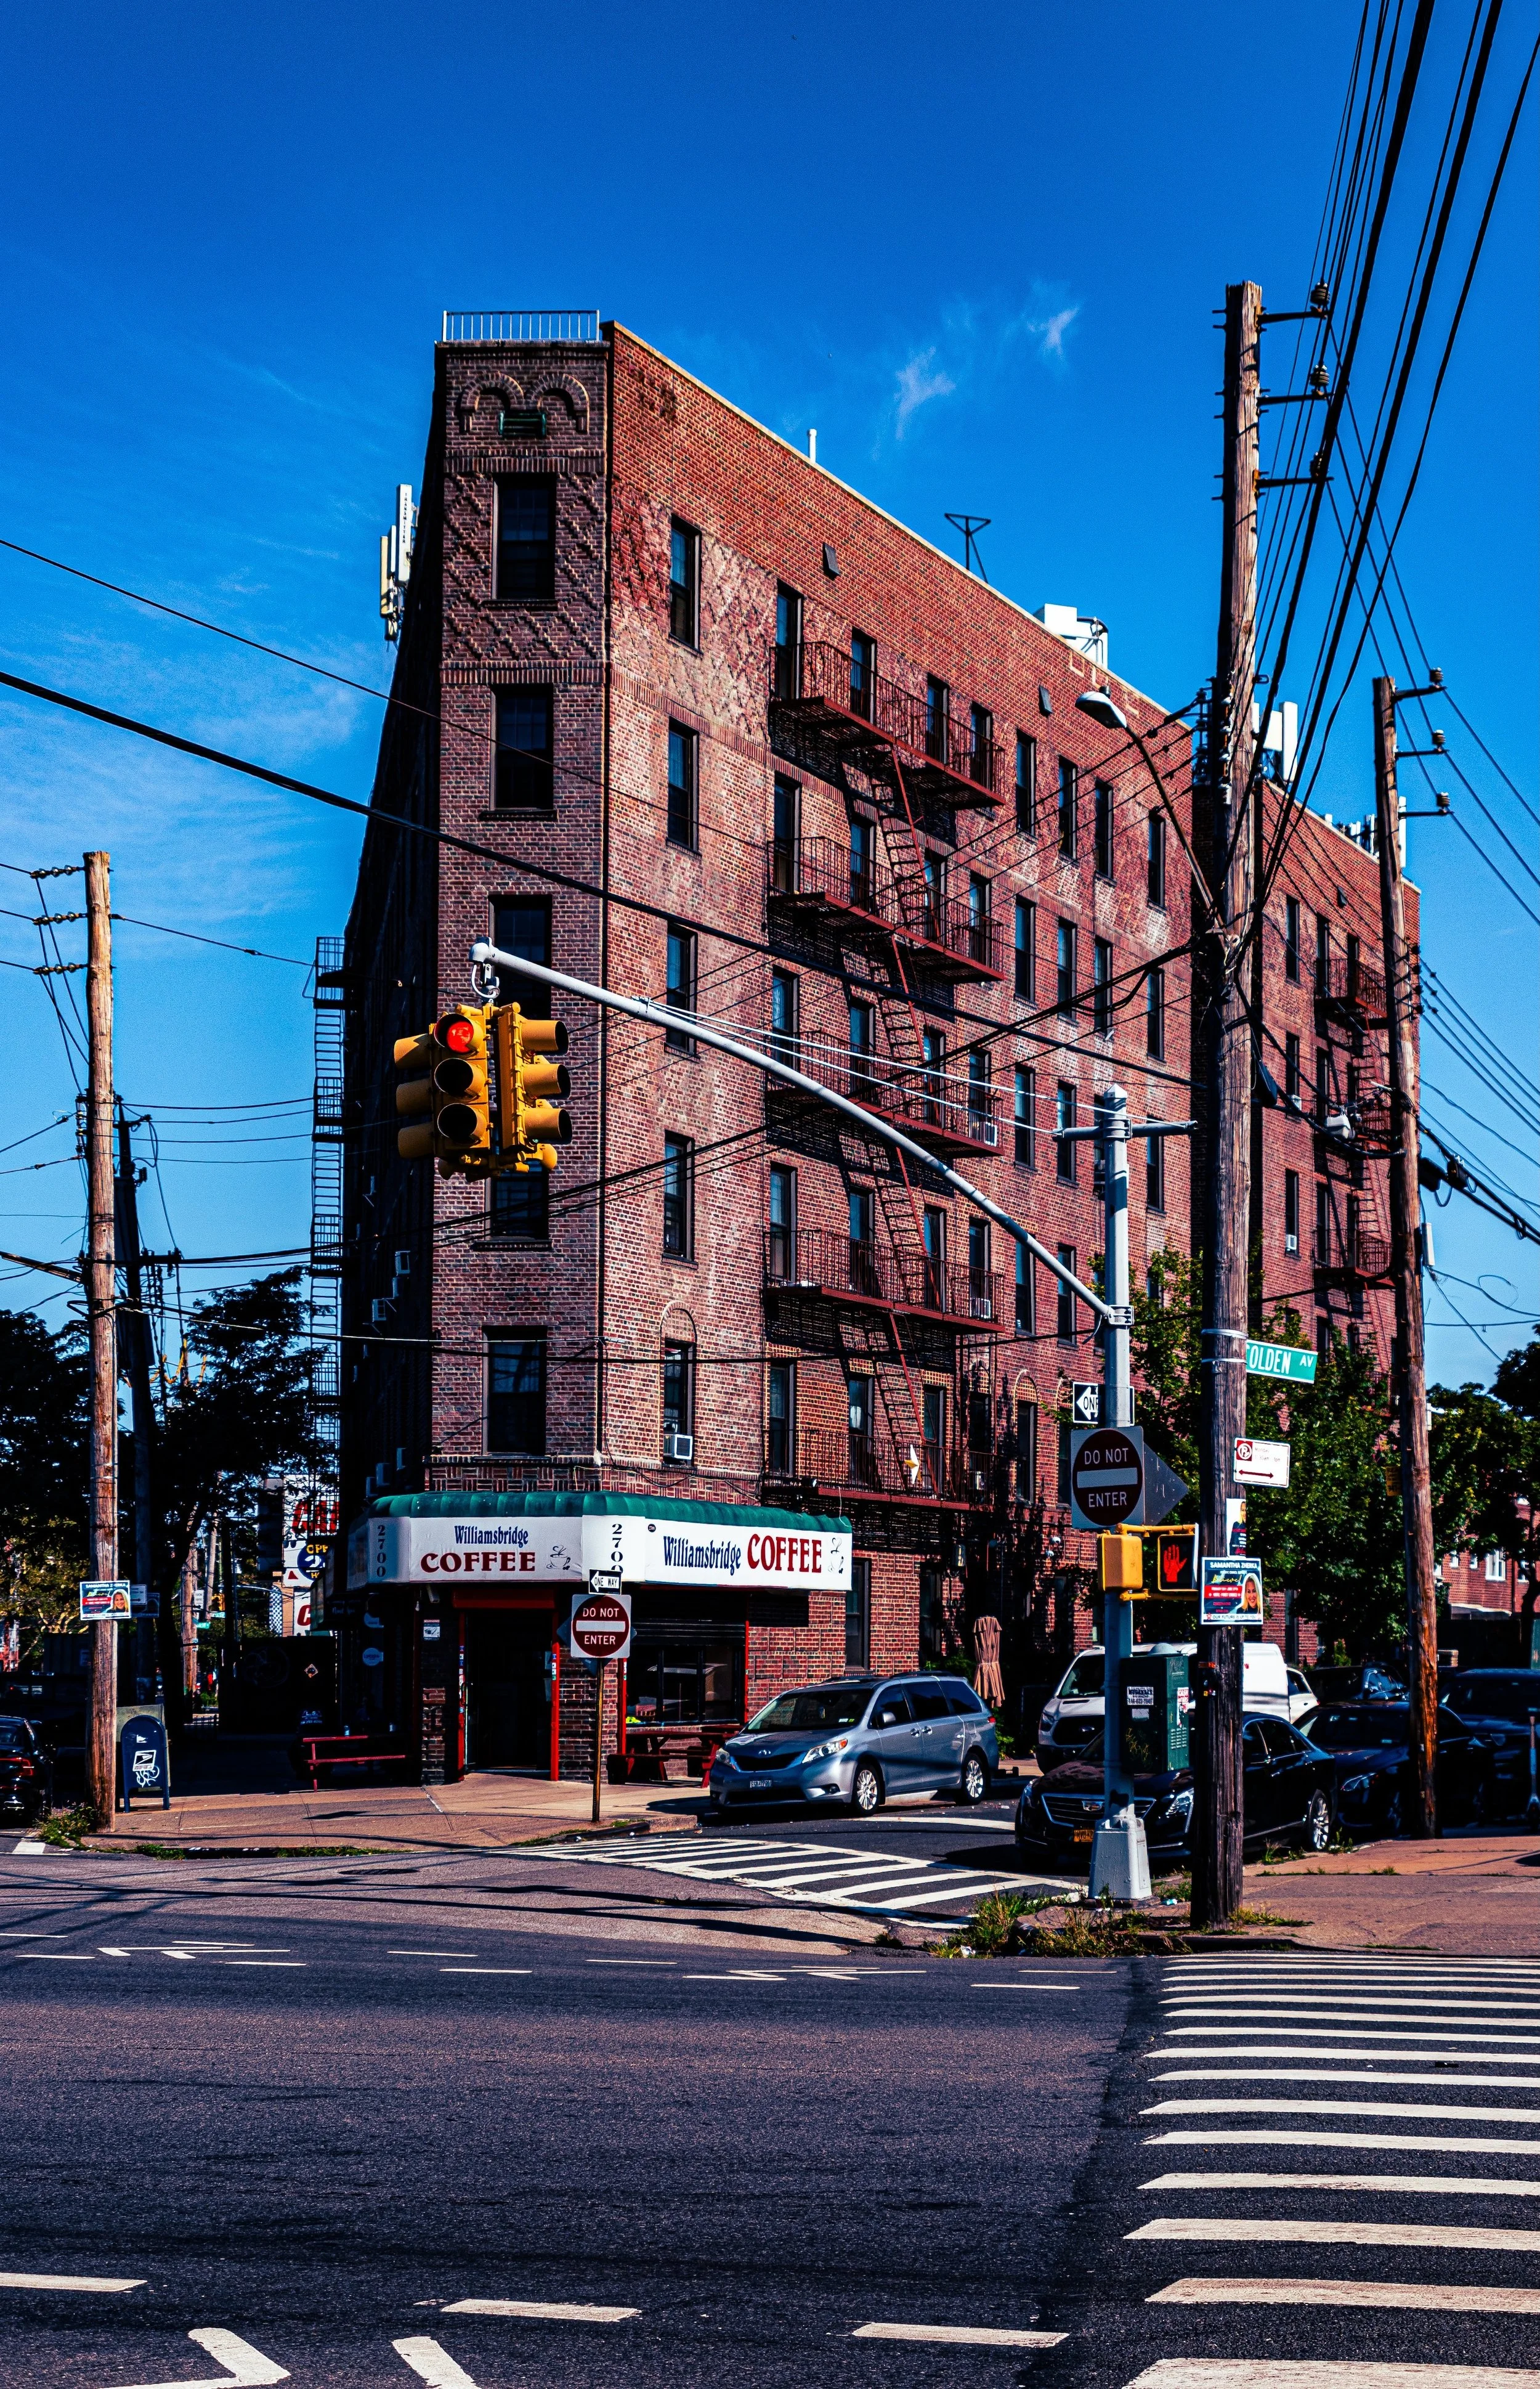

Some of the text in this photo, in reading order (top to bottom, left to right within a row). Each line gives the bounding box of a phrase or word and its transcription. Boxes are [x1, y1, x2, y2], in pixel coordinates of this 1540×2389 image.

[1300, 1354, 1314, 1367] AV
[1084, 1448, 1129, 1465] DO NOT
[1088, 1491, 1127, 1508] ENTER
[455, 1525, 529, 1549] Williamsbridge
[377, 1524, 387, 1577] 2700
[663, 1534, 822, 1576] Williamsbridge COFFEE
[420, 1552, 536, 1573] COFFEE
[594, 1577, 618, 1587] ONE WAY
[583, 1608, 619, 1618] DO NOT
[585, 1635, 616, 1645] ENTER
